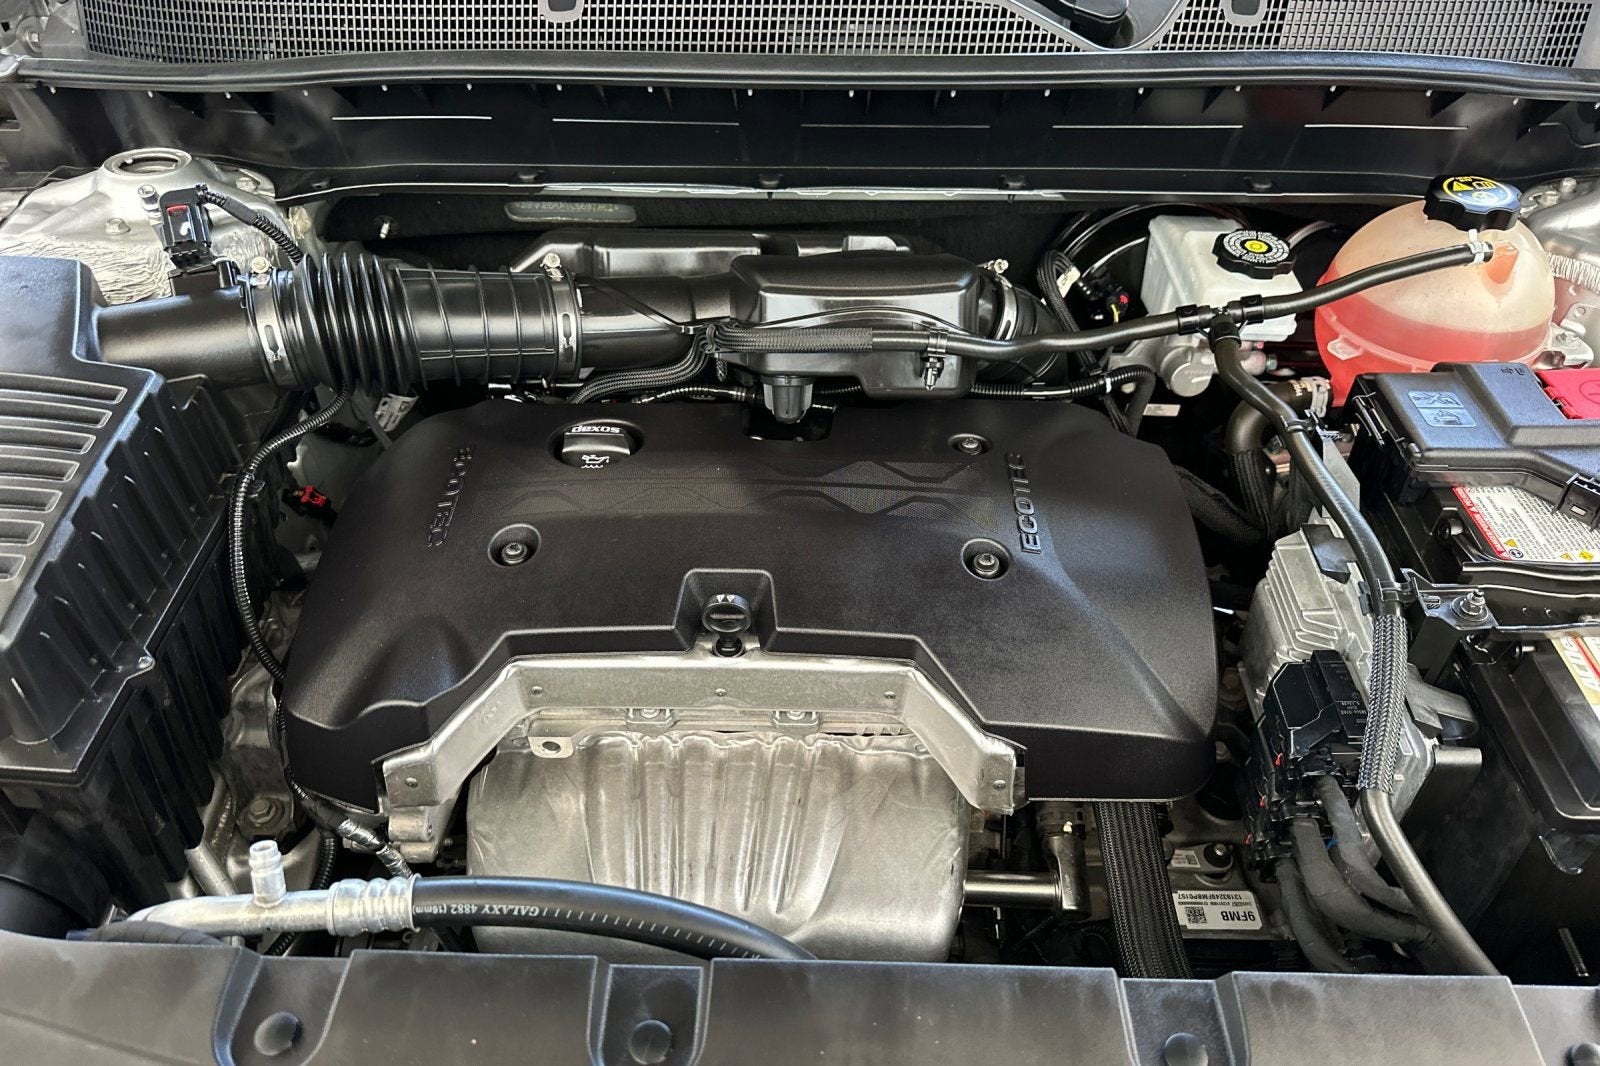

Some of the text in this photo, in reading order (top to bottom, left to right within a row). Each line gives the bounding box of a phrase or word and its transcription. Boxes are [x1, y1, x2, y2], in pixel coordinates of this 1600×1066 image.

[571, 425, 621, 434] dexos
[450, 903, 478, 914] 4882
[481, 904, 540, 916] GALAXY
[1220, 911, 1256, 922] 9FMB
